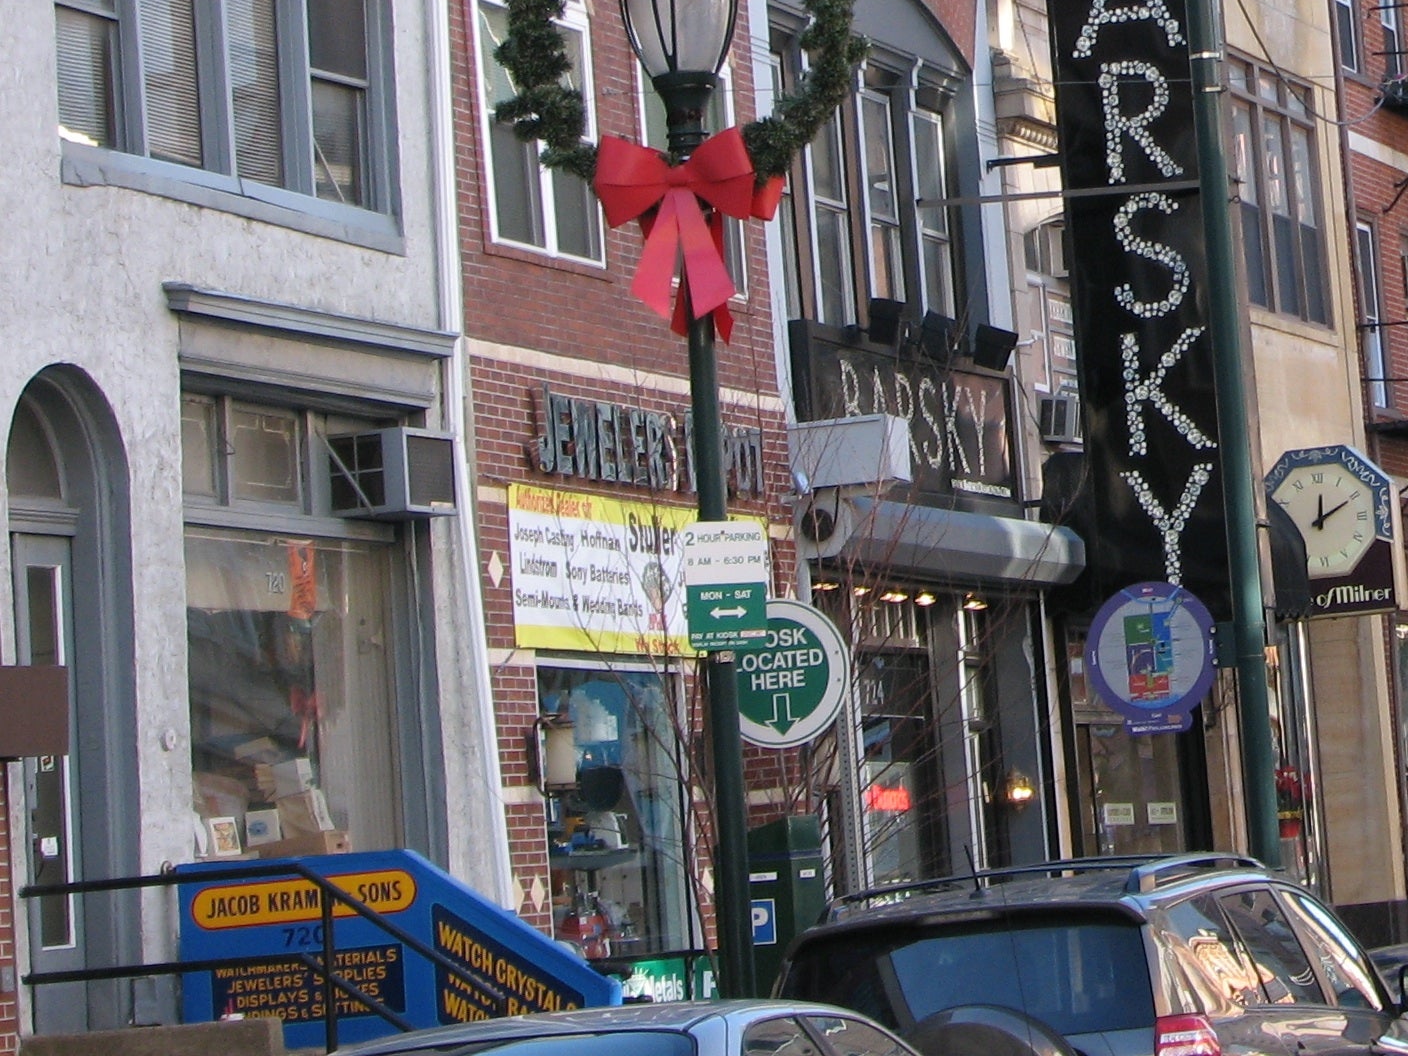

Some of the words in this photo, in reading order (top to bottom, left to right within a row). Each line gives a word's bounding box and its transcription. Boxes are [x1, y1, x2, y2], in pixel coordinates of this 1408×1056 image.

[539, 382, 678, 492] JEWELERS
[514, 522, 544, 546] Joseph
[685, 531, 695, 546] 2
[697, 533, 721, 543] HOUR
[725, 532, 761, 542] PARKING
[698, 557, 711, 565] AM
[723, 556, 744, 565] 6:30
[748, 555, 761, 563] PM
[700, 591, 723, 600] MON
[734, 589, 752, 599] SAT
[1336, 585, 1392, 604] Milner
[765, 627, 808, 647] OSK
[751, 669, 807, 692] HERE
[206, 894, 261, 919] JACOB
[268, 887, 342, 912] KRAM
[358, 880, 403, 904] SONS
[751, 907, 769, 937] P
[438, 920, 494, 976] WATCH
[214, 962, 309, 980] WATCHMAKER
[317, 948, 397, 967] TERIALS
[236, 989, 310, 1009] DISPLAYS
